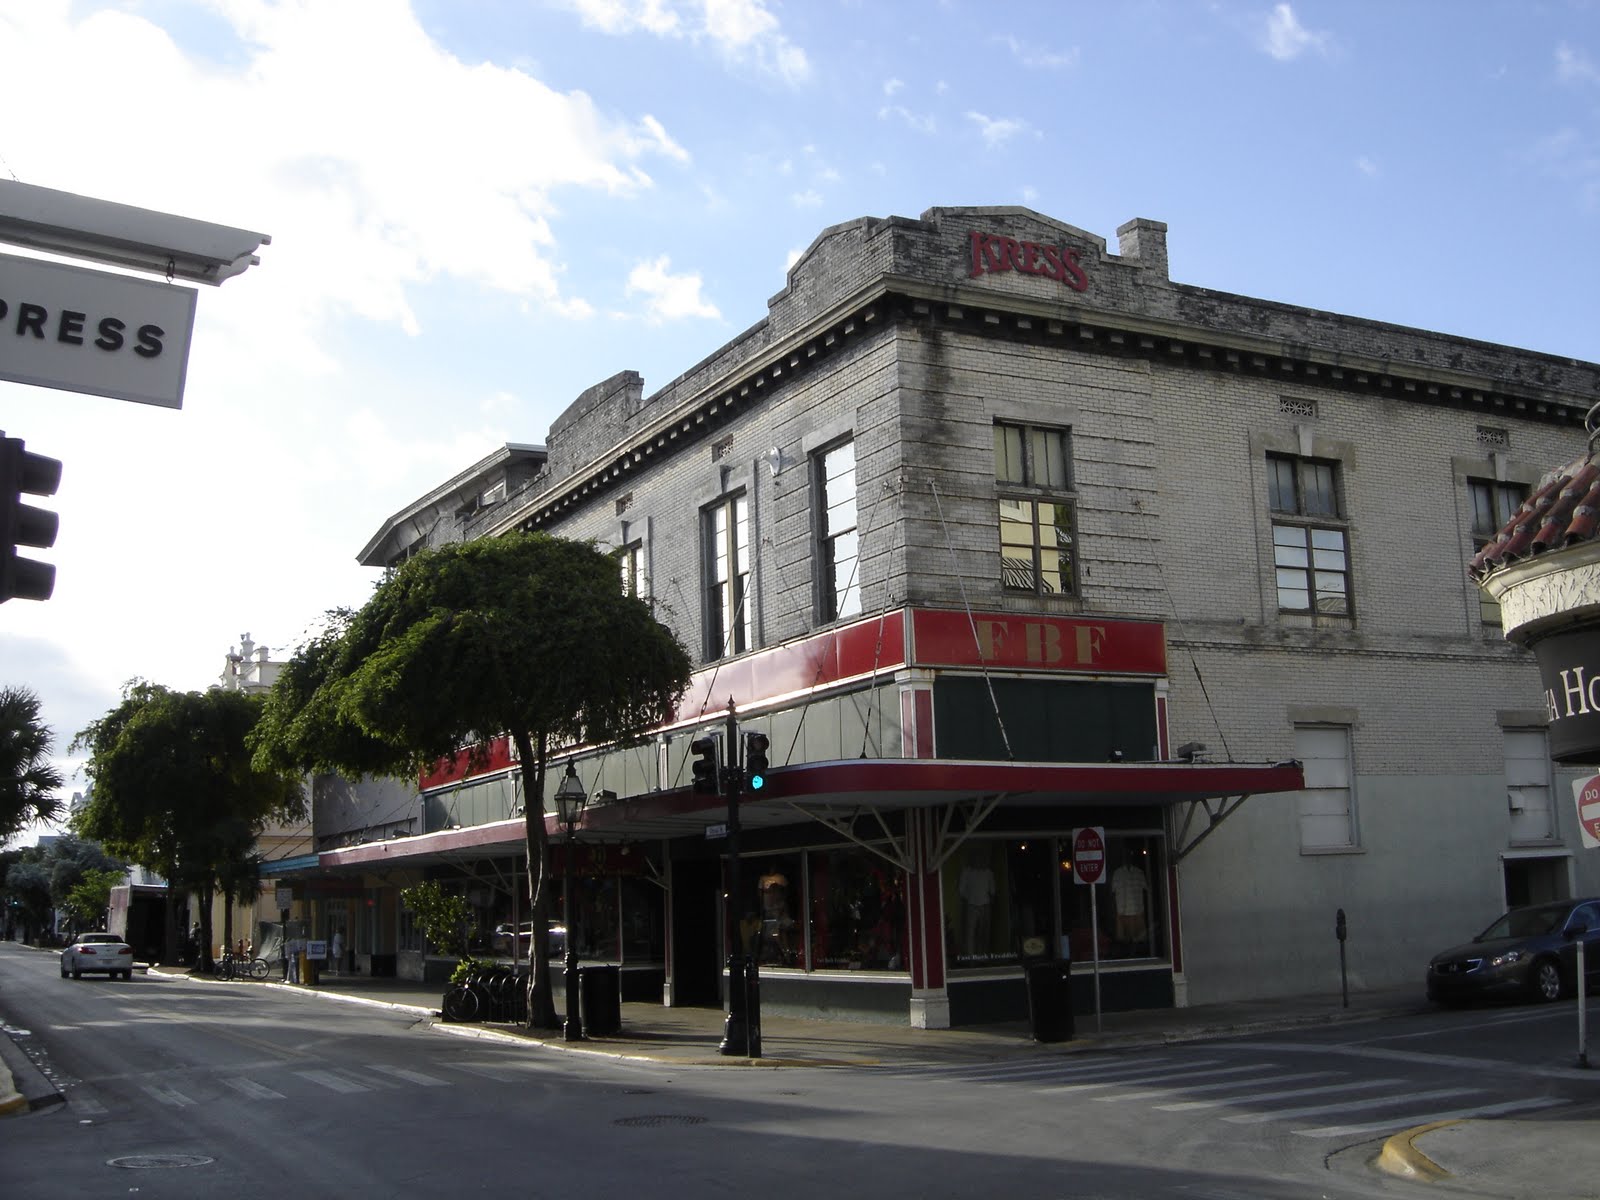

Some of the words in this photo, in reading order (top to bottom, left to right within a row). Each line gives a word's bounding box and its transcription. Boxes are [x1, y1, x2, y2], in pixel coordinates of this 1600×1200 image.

[968, 230, 1088, 292] KRESS
[1585, 788, 1599, 800] DO
[1077, 839, 1085, 848] DO
[1087, 838, 1100, 848] NOT
[1080, 863, 1099, 872] ENTER
